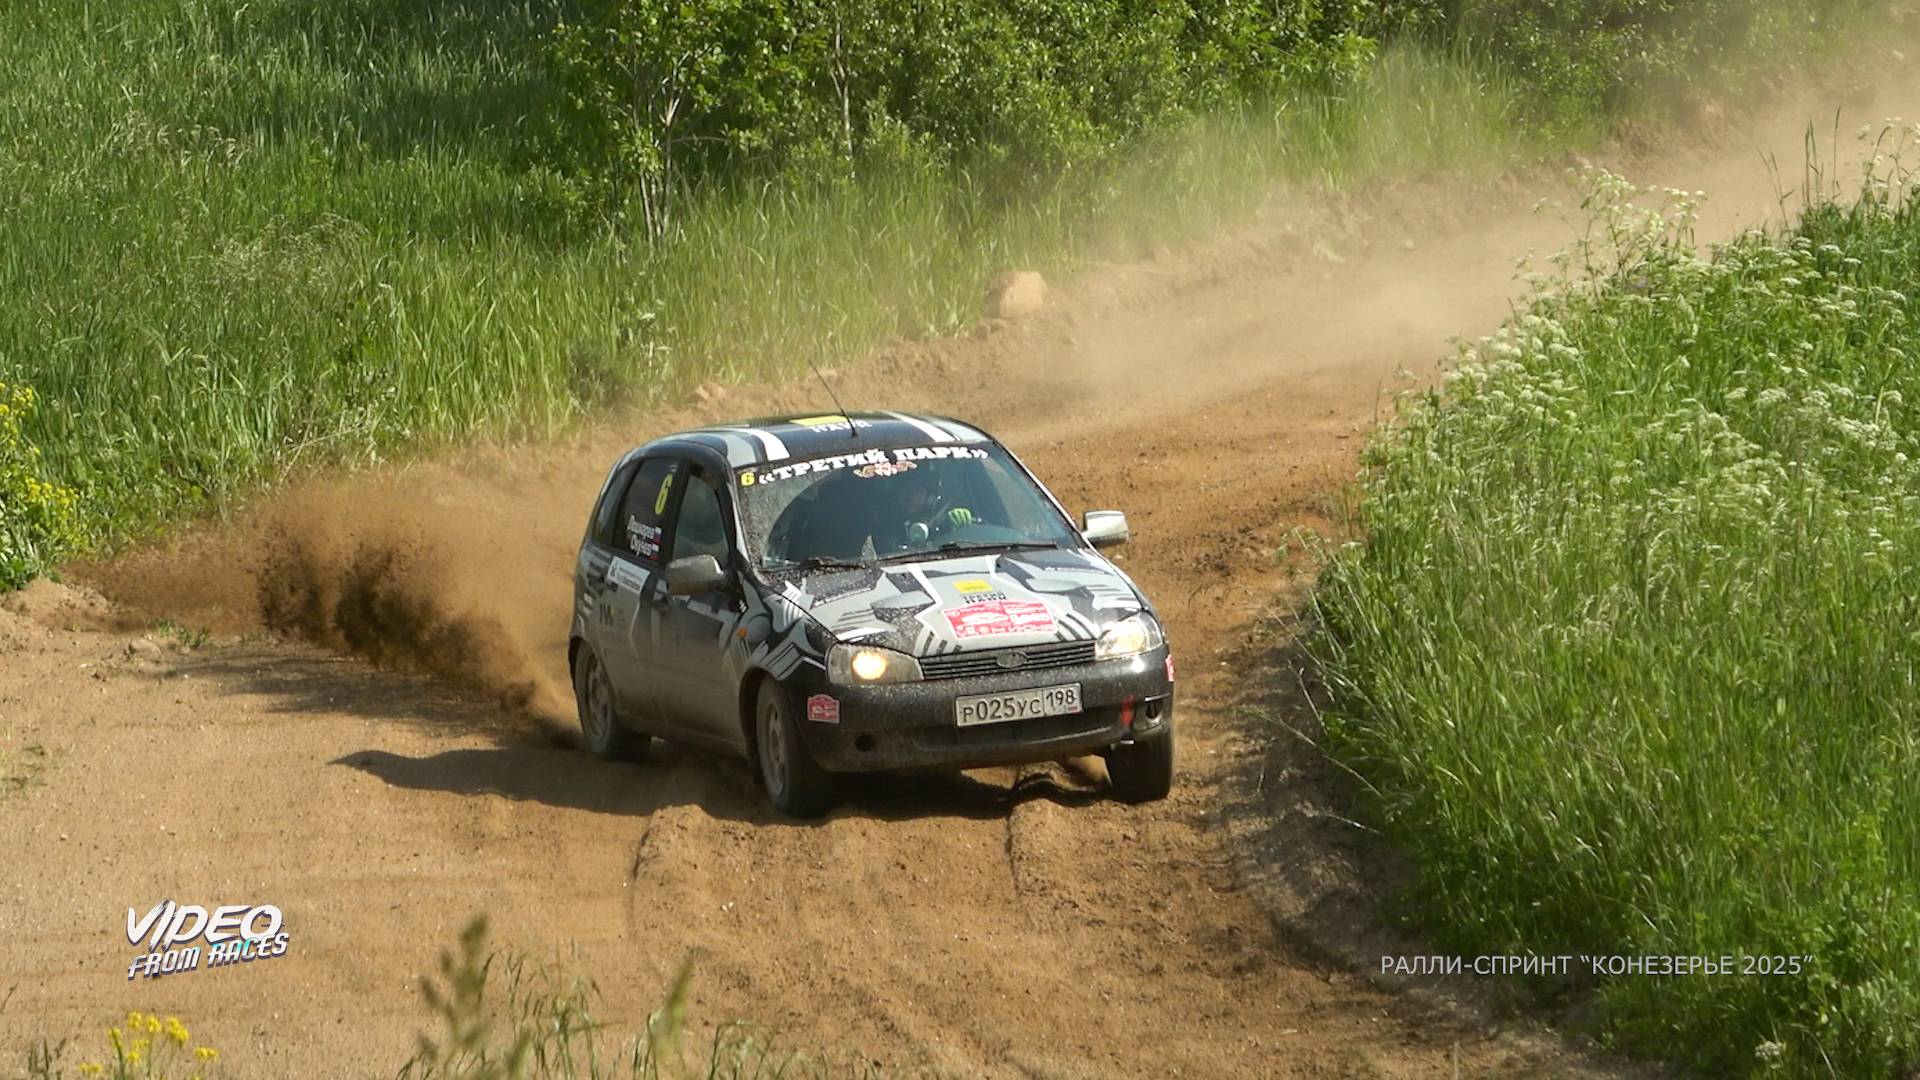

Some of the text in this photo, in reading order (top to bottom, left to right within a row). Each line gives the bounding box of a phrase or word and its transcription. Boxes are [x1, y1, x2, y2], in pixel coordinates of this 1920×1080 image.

[741, 472, 755, 486] 6
[758, 446, 988, 485] «ТРЕТИЙ ПАРК»
[655, 473, 673, 515] 6
[1046, 689, 1076, 708] 198
